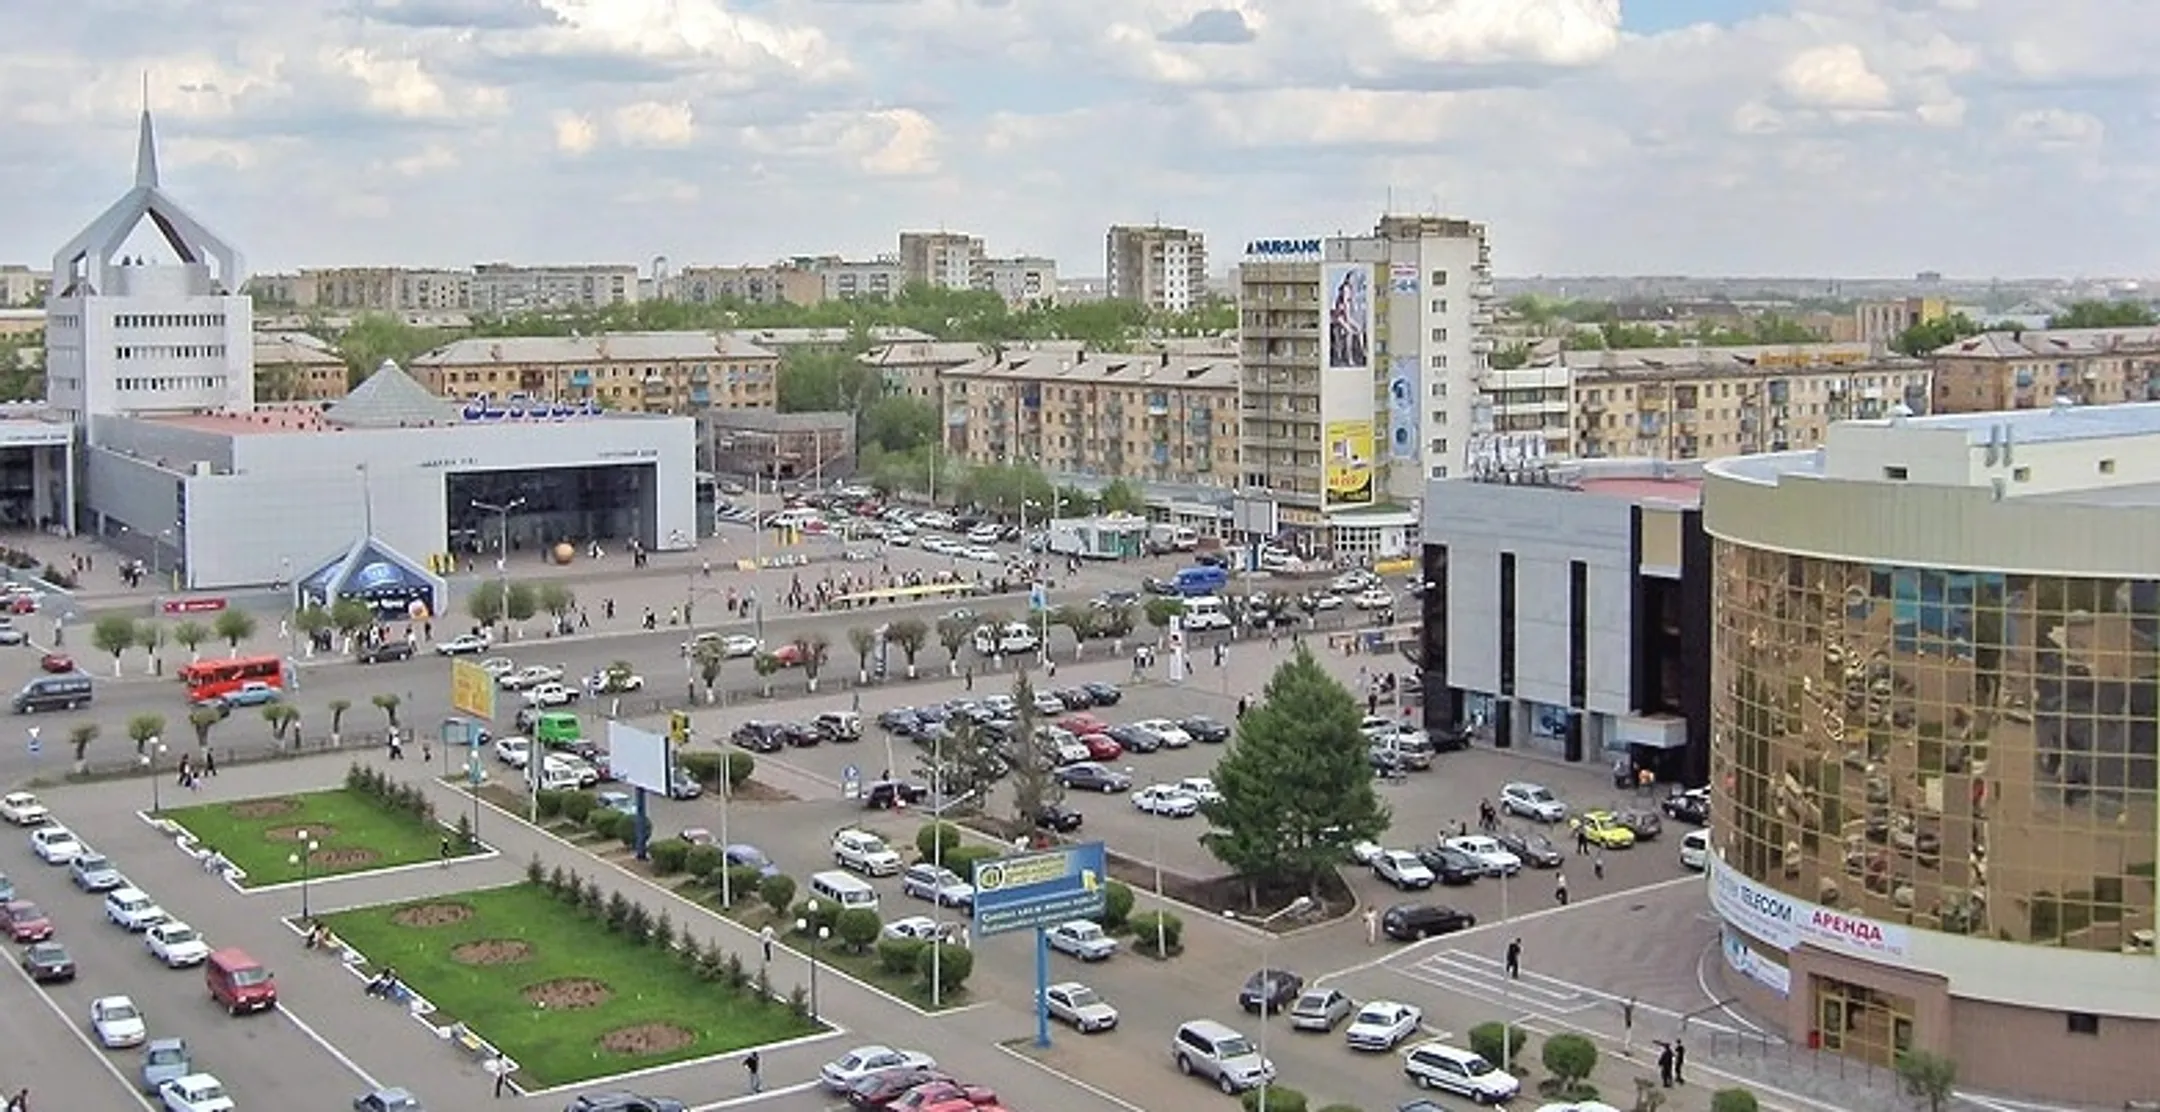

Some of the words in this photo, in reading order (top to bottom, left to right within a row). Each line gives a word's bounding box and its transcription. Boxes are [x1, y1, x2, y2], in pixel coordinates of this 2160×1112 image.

[1255, 240, 1320, 254] NURBANK
[1741, 886, 1791, 921] TELECOM
[1812, 911, 1882, 940] АРЕНДА
